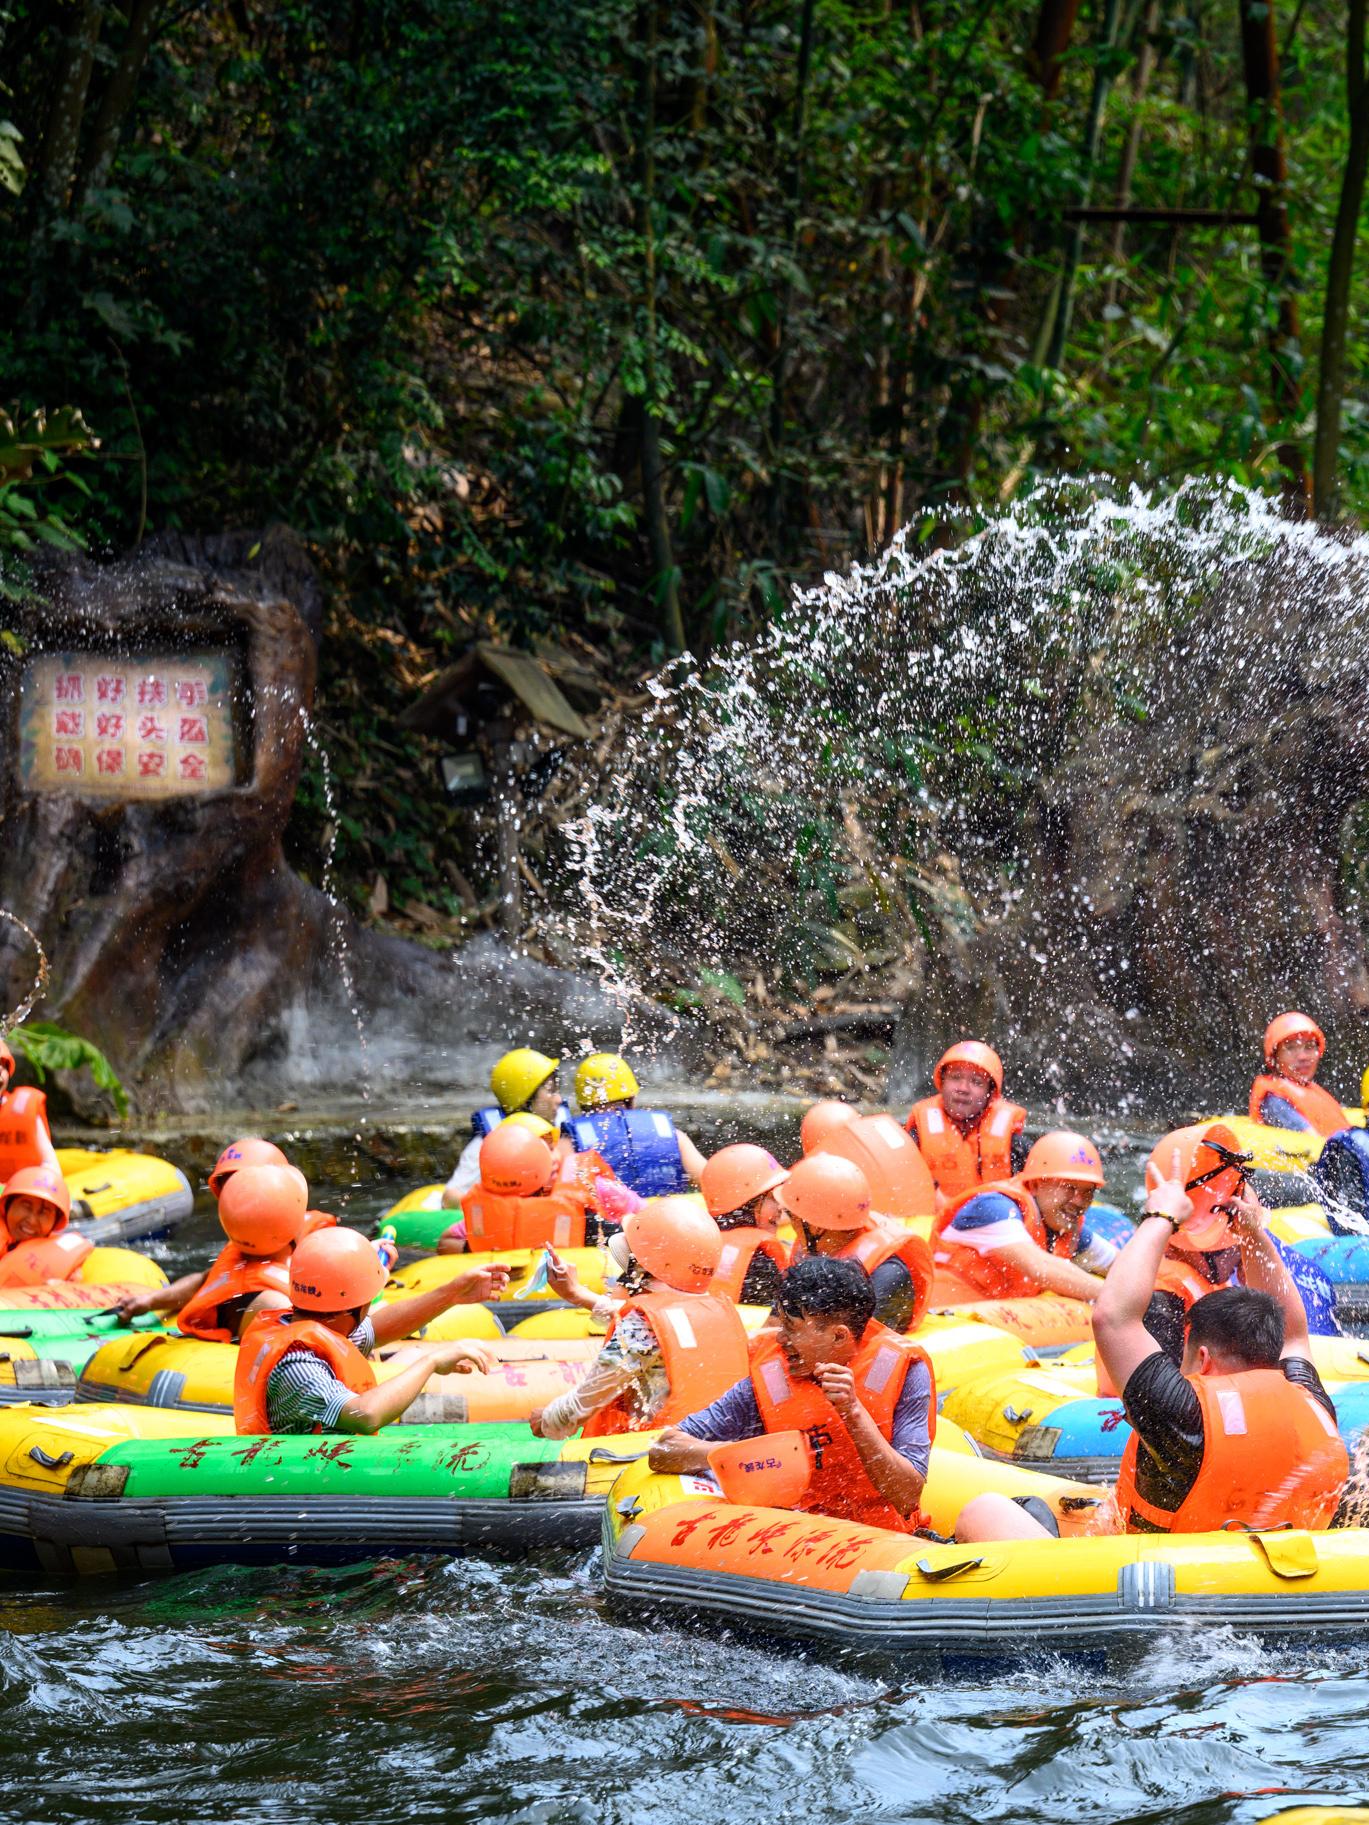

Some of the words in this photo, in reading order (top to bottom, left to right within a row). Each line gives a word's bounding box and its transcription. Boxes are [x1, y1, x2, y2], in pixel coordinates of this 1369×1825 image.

[55, 710, 206, 742] 戴好头盔
[55, 746, 205, 780] 确保安全
